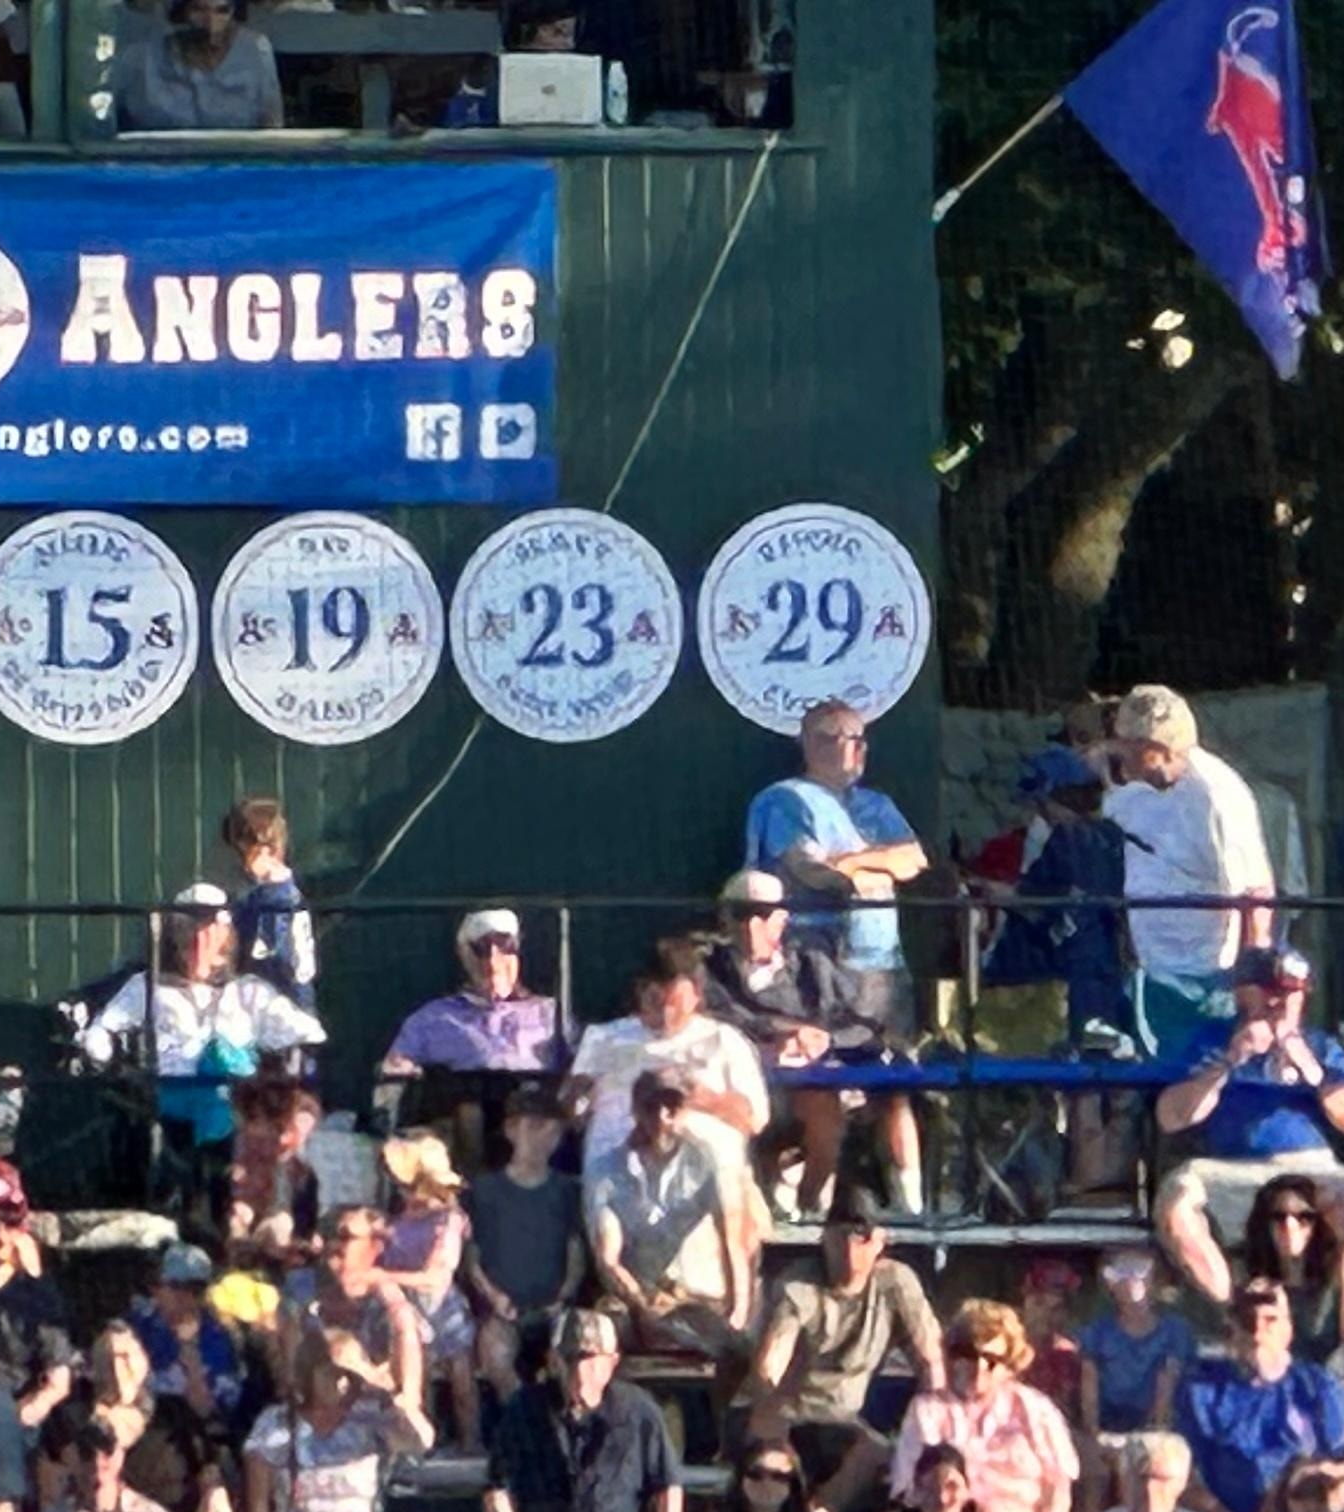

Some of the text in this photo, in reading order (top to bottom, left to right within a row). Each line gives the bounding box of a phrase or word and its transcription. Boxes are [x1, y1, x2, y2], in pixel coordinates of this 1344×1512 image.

[60, 252, 536, 363] ANGLERS
[38, 583, 131, 671] 15
[283, 585, 370, 673] 19
[517, 582, 614, 668] 23
[762, 576, 863, 666] 29
